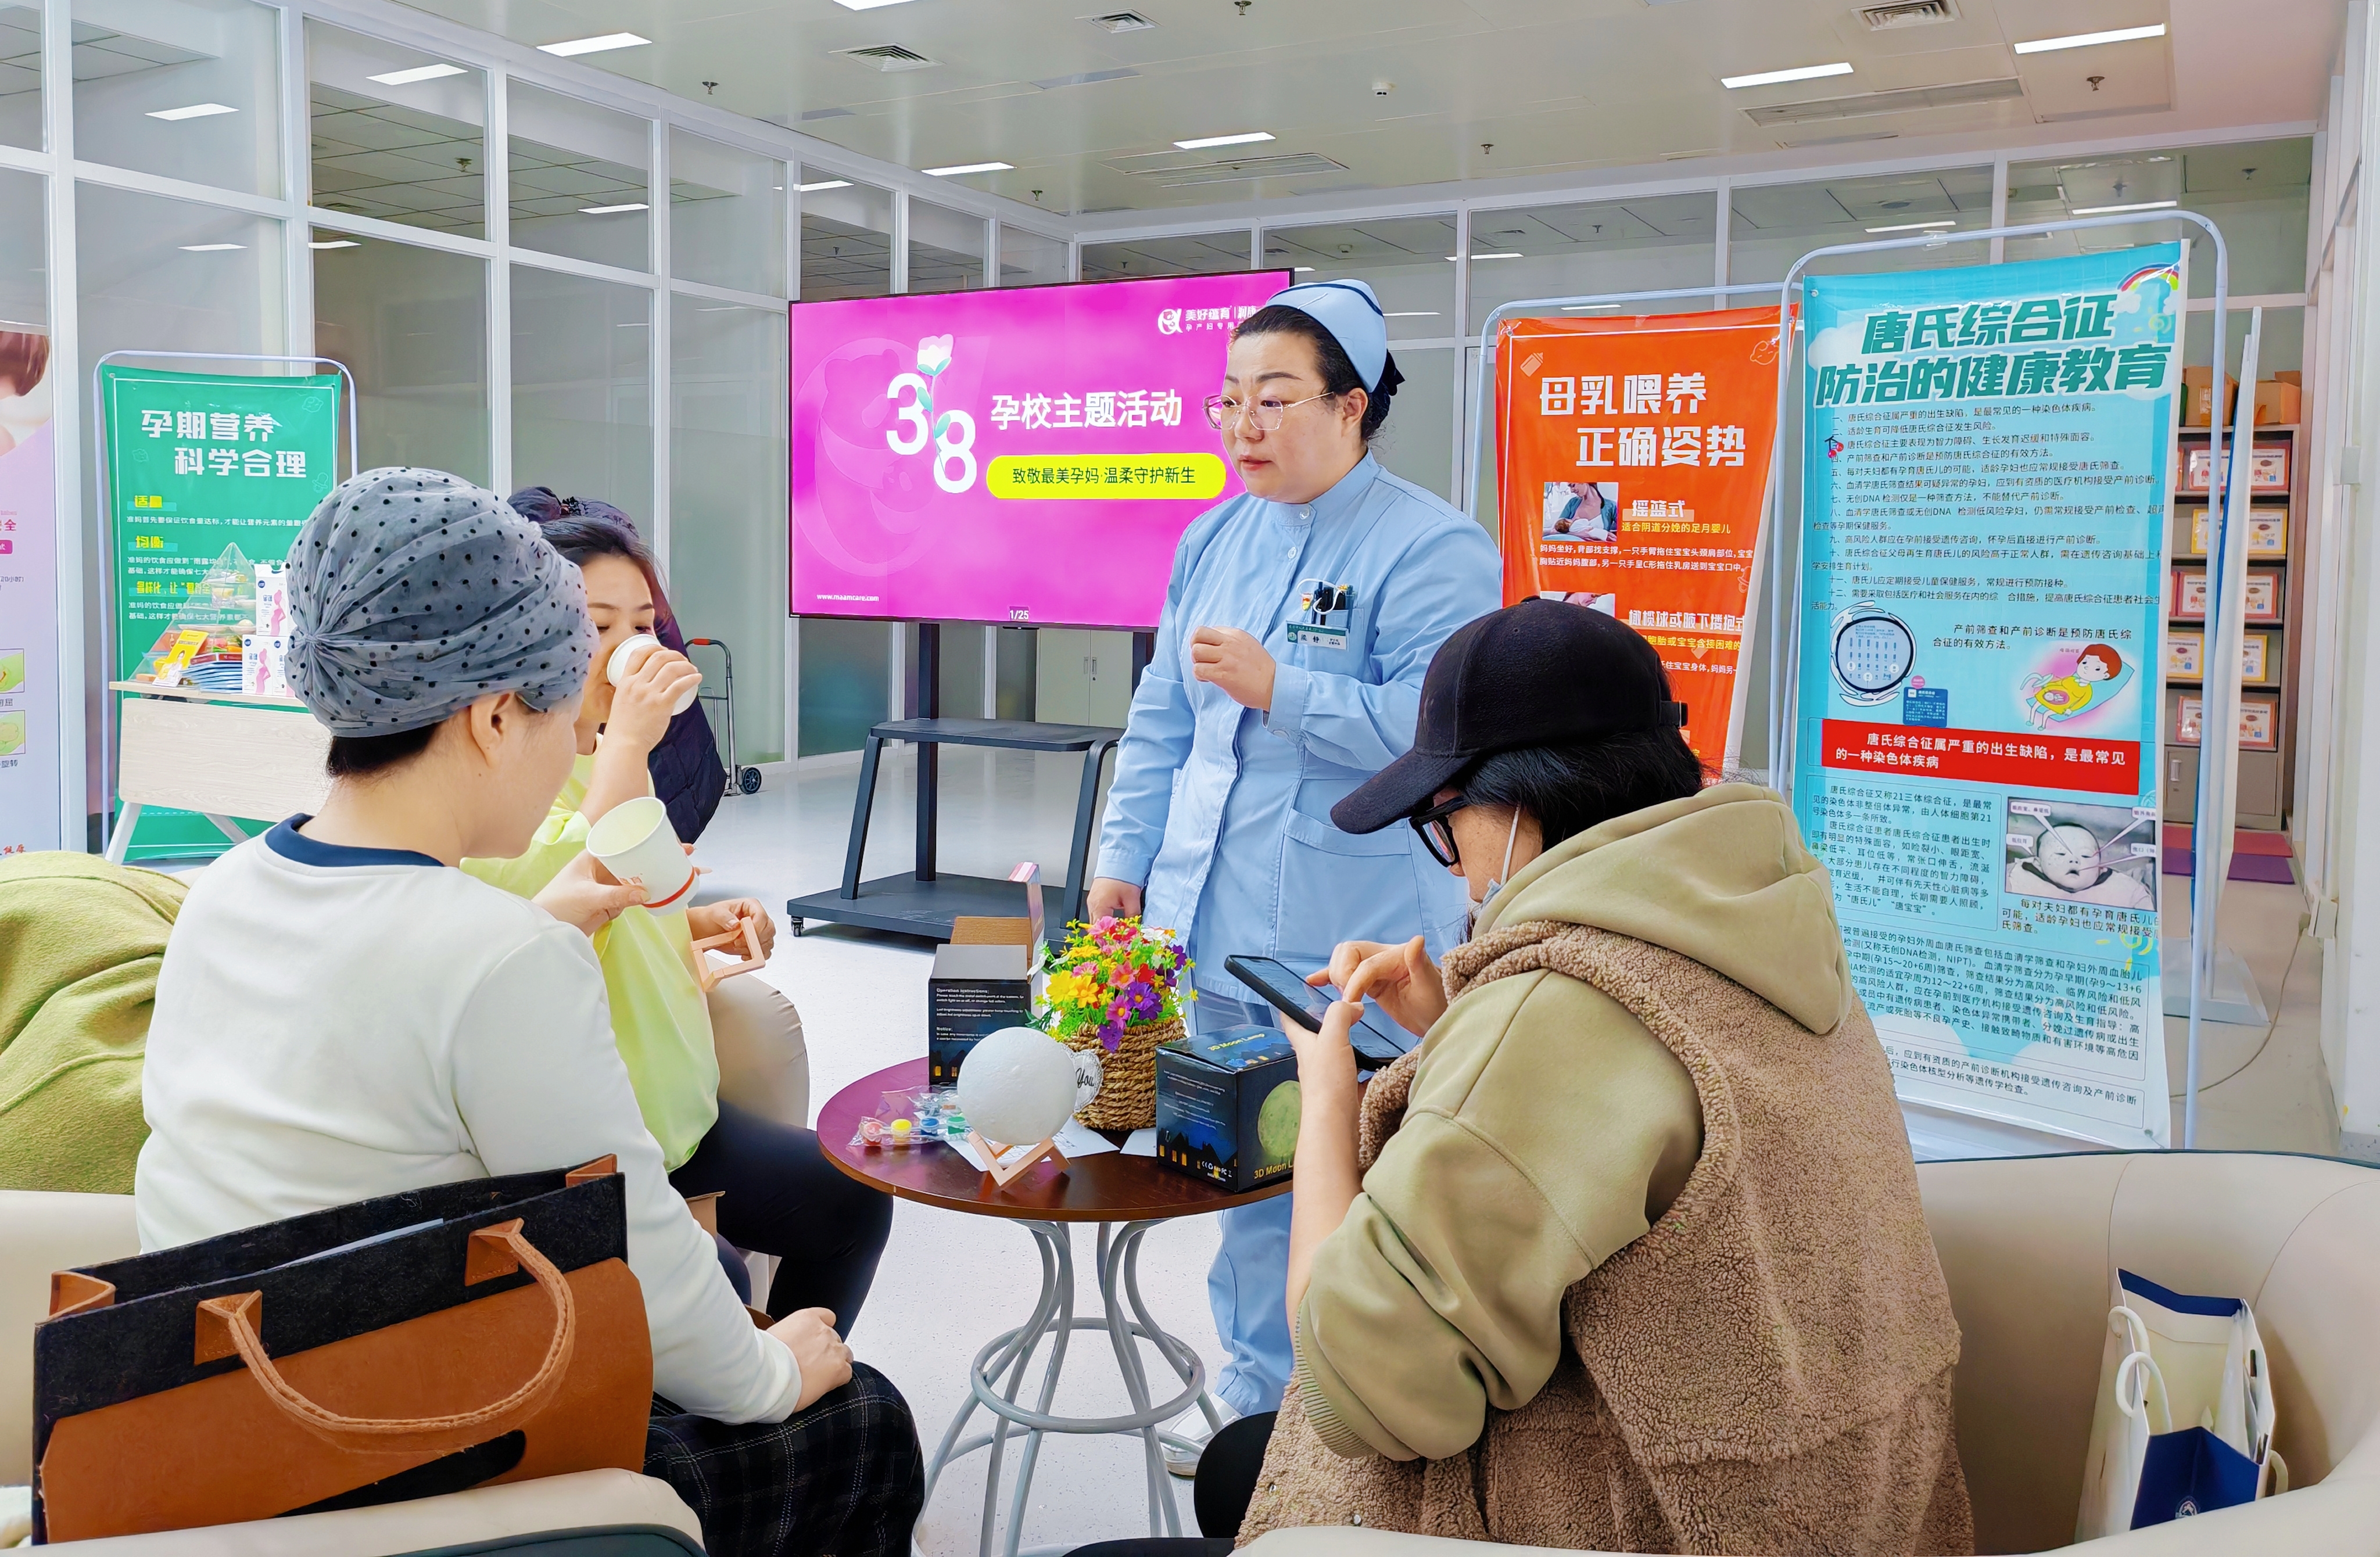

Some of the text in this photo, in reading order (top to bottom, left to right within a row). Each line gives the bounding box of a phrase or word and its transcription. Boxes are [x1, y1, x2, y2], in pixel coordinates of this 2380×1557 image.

[1861, 293, 2120, 355] 唐氏综合征
[1816, 344, 2172, 406] 防治的健康教育
[991, 388, 1183, 430] 孕校主题活动
[1539, 372, 1707, 415] 母乳喂养
[141, 410, 275, 442] 孕期营养
[886, 372, 978, 494] 3 8
[174, 447, 307, 478] 科学合理
[1575, 425, 1746, 467] 正确姿势
[1631, 500, 1686, 518] 摇篮式
[1621, 521, 1731, 534] 适合阴道分娩的足月婴儿
[1009, 609, 1029, 620] 1/25
[1933, 637, 2012, 651] 合征的有效方法。
[1953, 623, 2132, 640] 产前筛查和产前诊断是预防唐氏综
[1835, 747, 1940, 769] 的一种染色体疾病
[1866, 732, 2126, 766] 唐氏综合征属严重的出生缺陷，是最常见
[2002, 920, 2038, 934] 氏筛查。
[1840, 925, 2142, 981] 被普遍接受的孕妇外周血唐氏筛查包括血清学筛查和孕妇外周血胎儿
[1855, 988, 2139, 1047] 成员中有遗传病患者、染色体异常携带者、分娩过遗传病或出生
[1863, 1000, 2139, 1061] 流产或死胎等不良孕产史、接触致畸物质和有害环境等高危因
[1076, 1067, 1095, 1089] You
[1888, 1058, 2028, 1096] 行染色体核型分析等遗传学检查。
[1253, 1169, 1264, 1179] 3D
[1266, 1163, 1286, 1175] Moon
